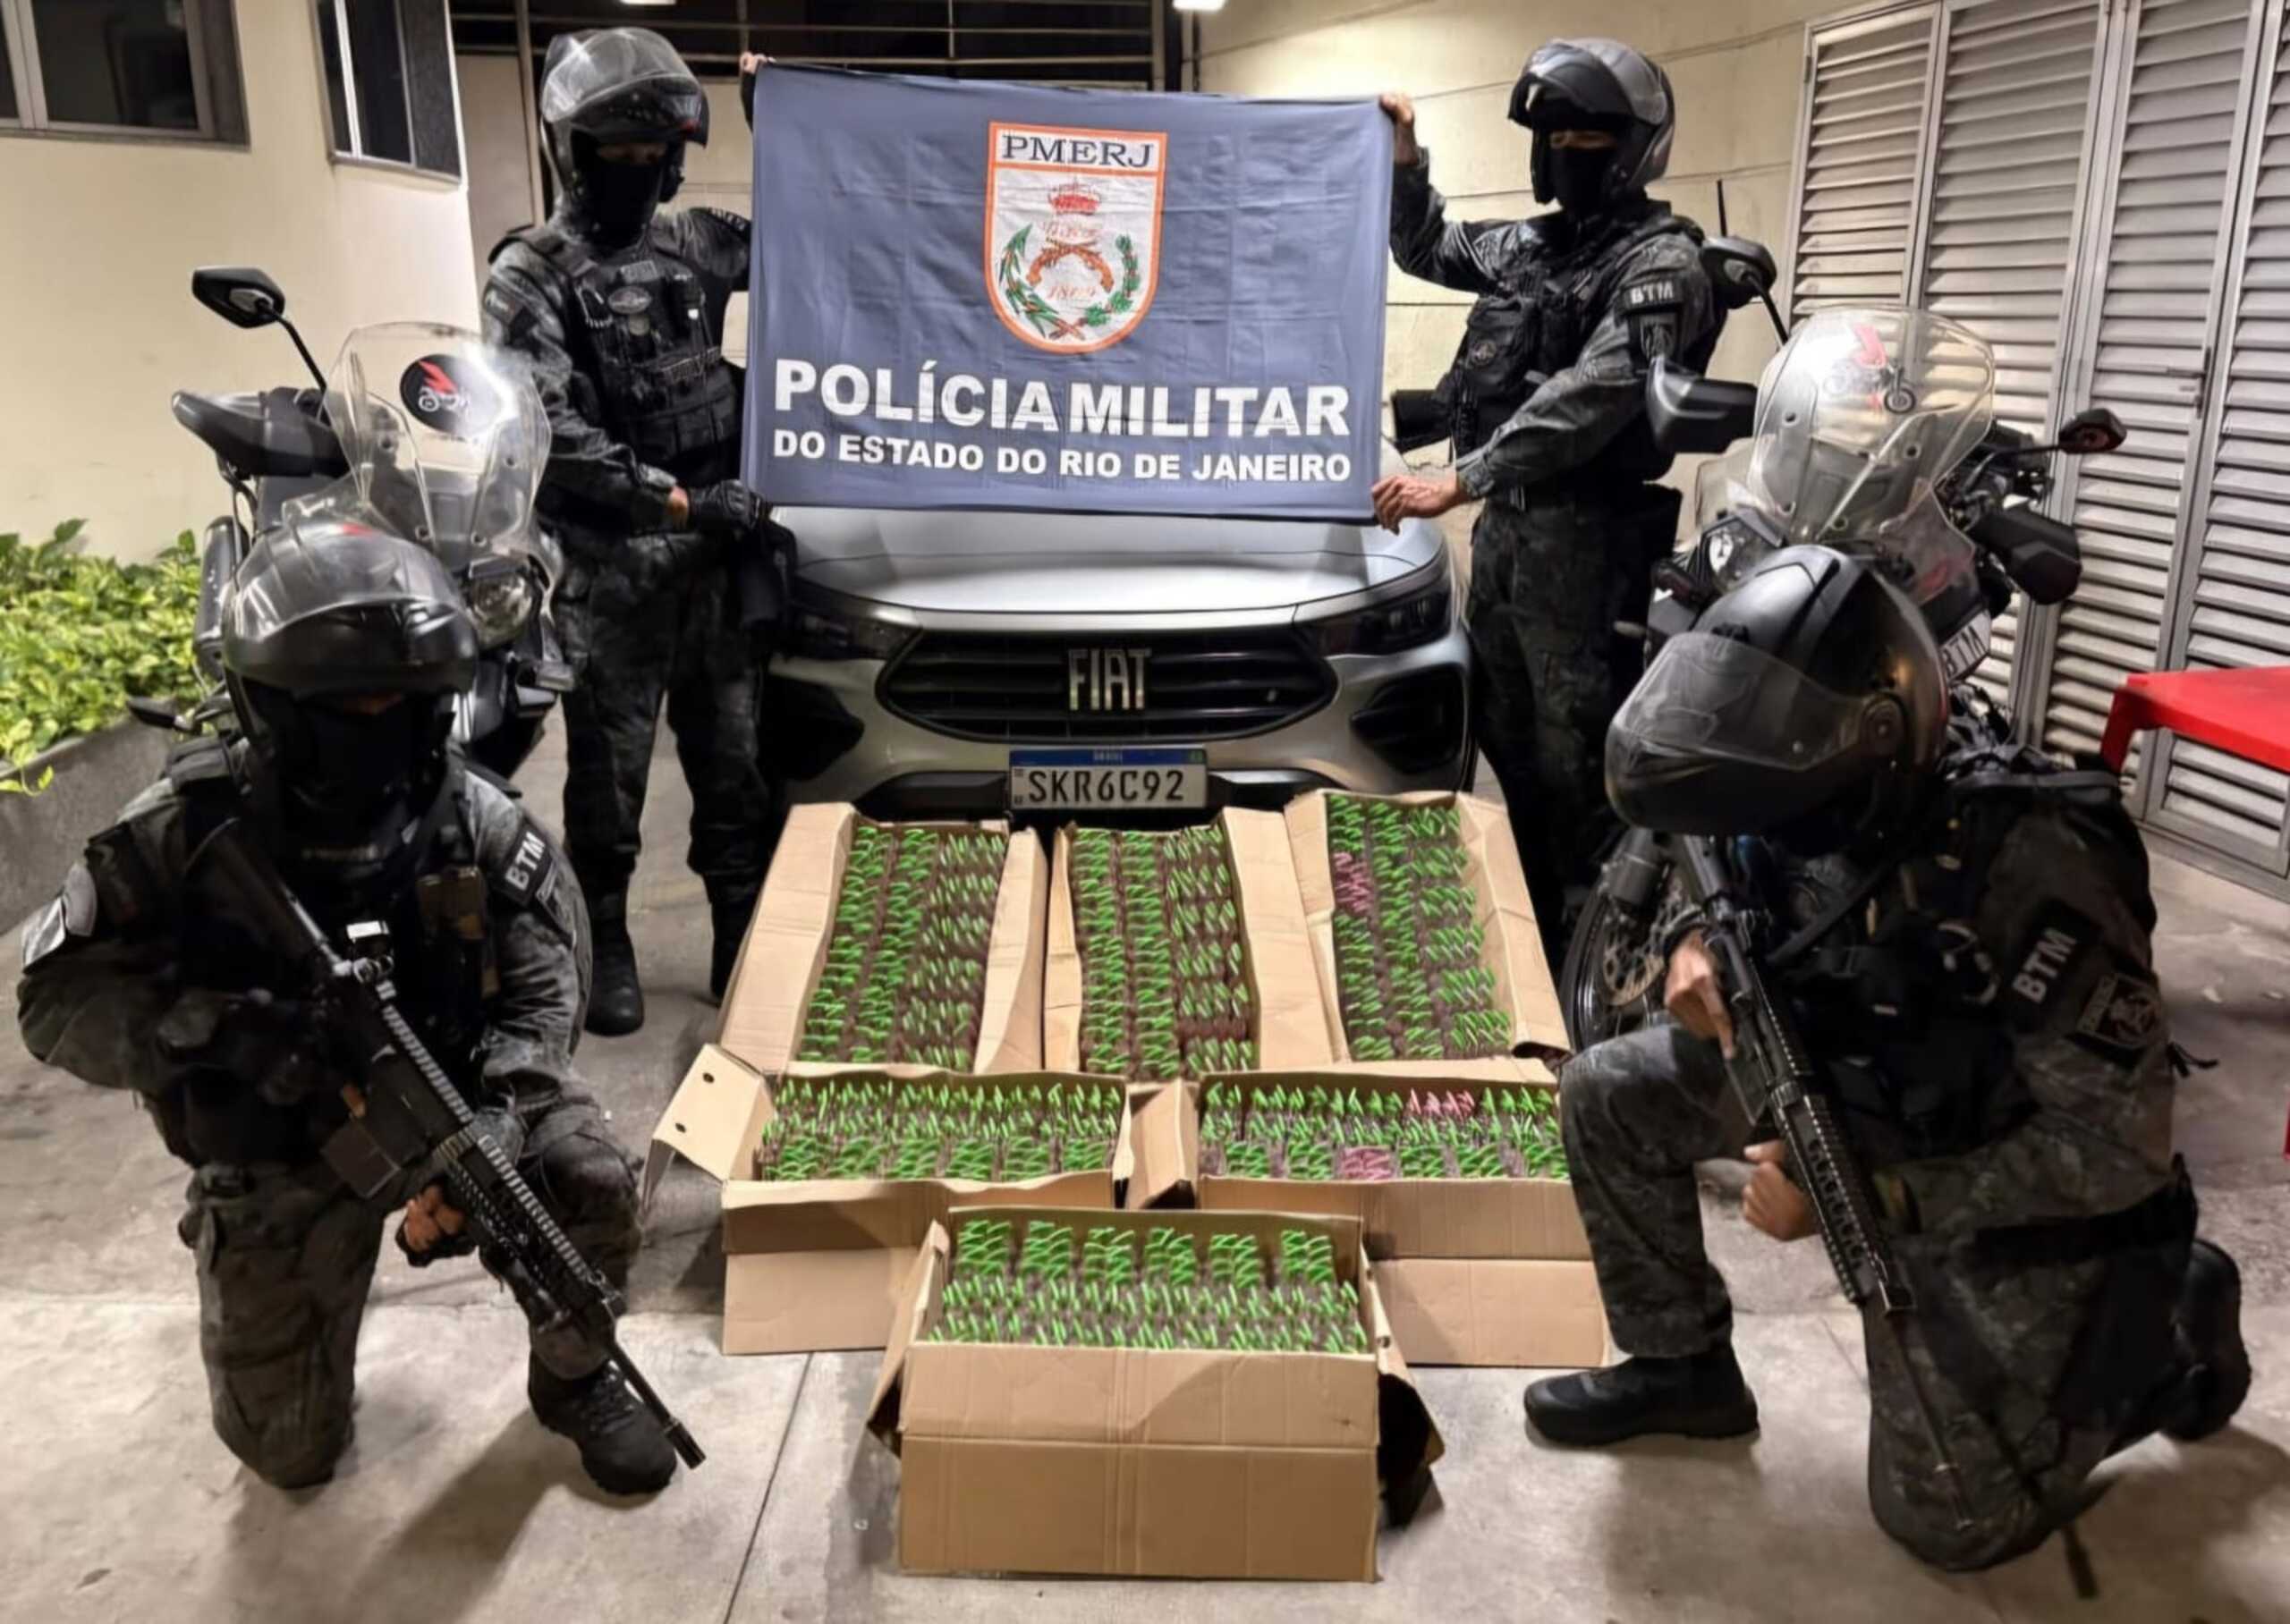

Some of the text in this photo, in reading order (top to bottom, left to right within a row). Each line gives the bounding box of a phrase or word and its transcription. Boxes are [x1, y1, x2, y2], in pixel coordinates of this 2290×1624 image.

[1002, 133, 1154, 168] PMERJ
[1630, 280, 1674, 304] BTM
[774, 358, 1352, 438] POLÍCIA MILITAR
[774, 427, 1353, 484] DO ESTADO DO RIO DE JANEIRO
[1068, 648, 1152, 710] FIAT
[1941, 625, 1988, 679] BTM
[1028, 769, 1184, 803] SKR6C92
[505, 830, 547, 892] BTM
[2013, 926, 2077, 1004] BTM
